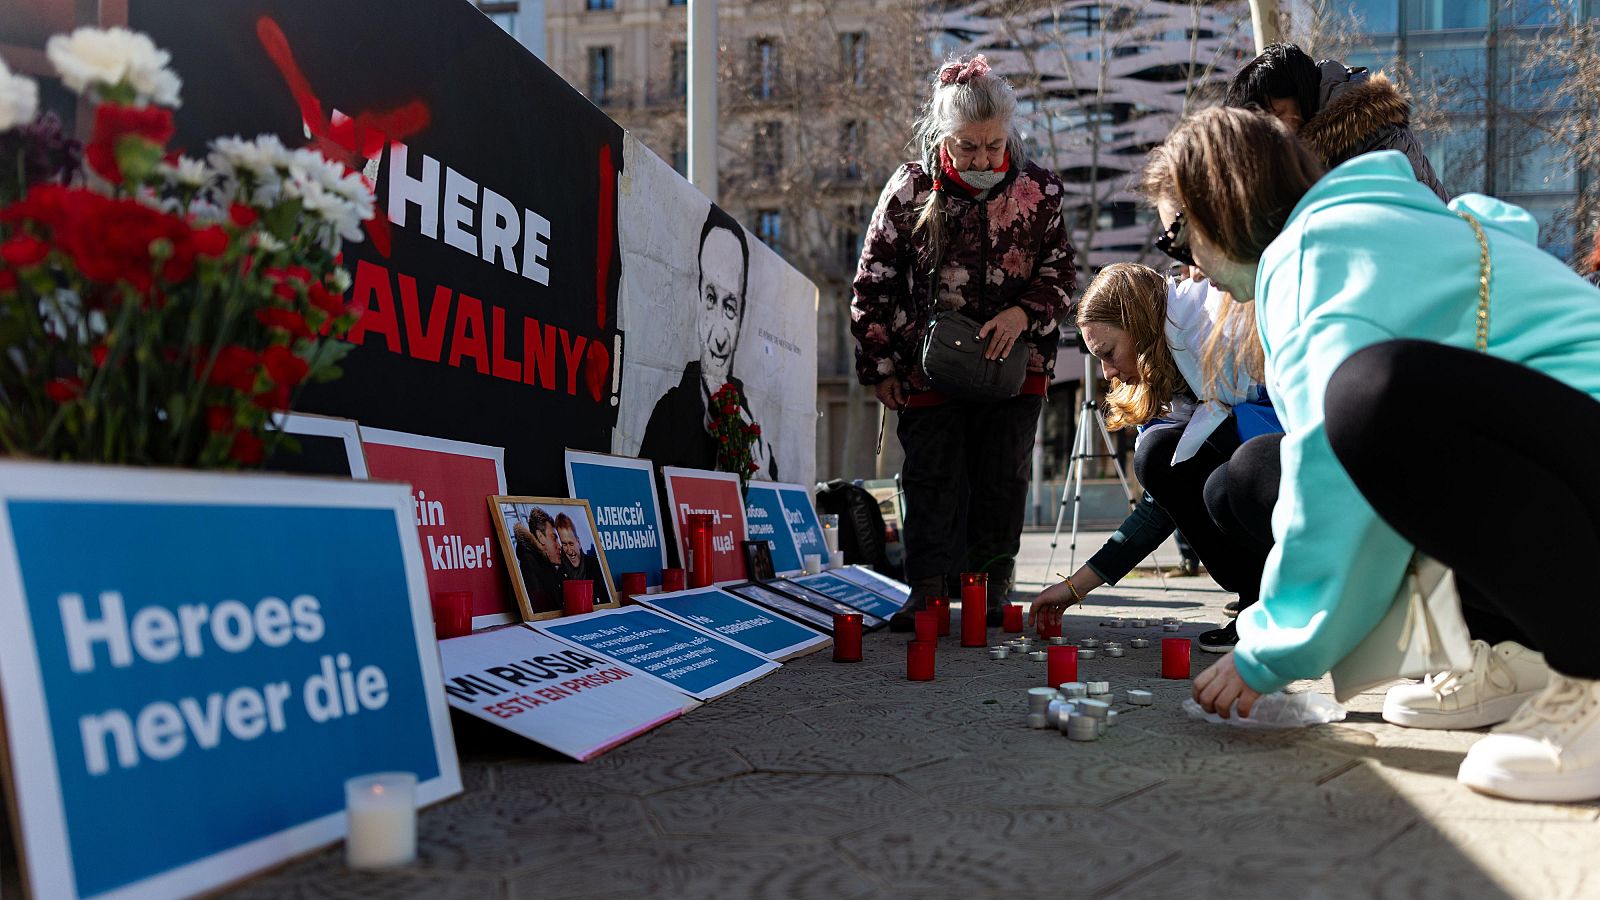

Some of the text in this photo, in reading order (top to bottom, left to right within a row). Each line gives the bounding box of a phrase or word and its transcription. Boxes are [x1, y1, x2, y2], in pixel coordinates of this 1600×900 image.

[328, 108, 550, 287] HERE
[597, 502, 645, 526] АЛЕКСЕЙ
[598, 525, 657, 551] АВАЛЬНЫЙ
[427, 535, 493, 570] killer!
[58, 590, 325, 673] Heroes
[445, 650, 607, 703] MI RUSIA
[483, 667, 634, 719] ESTÁ EN PRISIÓN
[79, 652, 390, 776] never die
